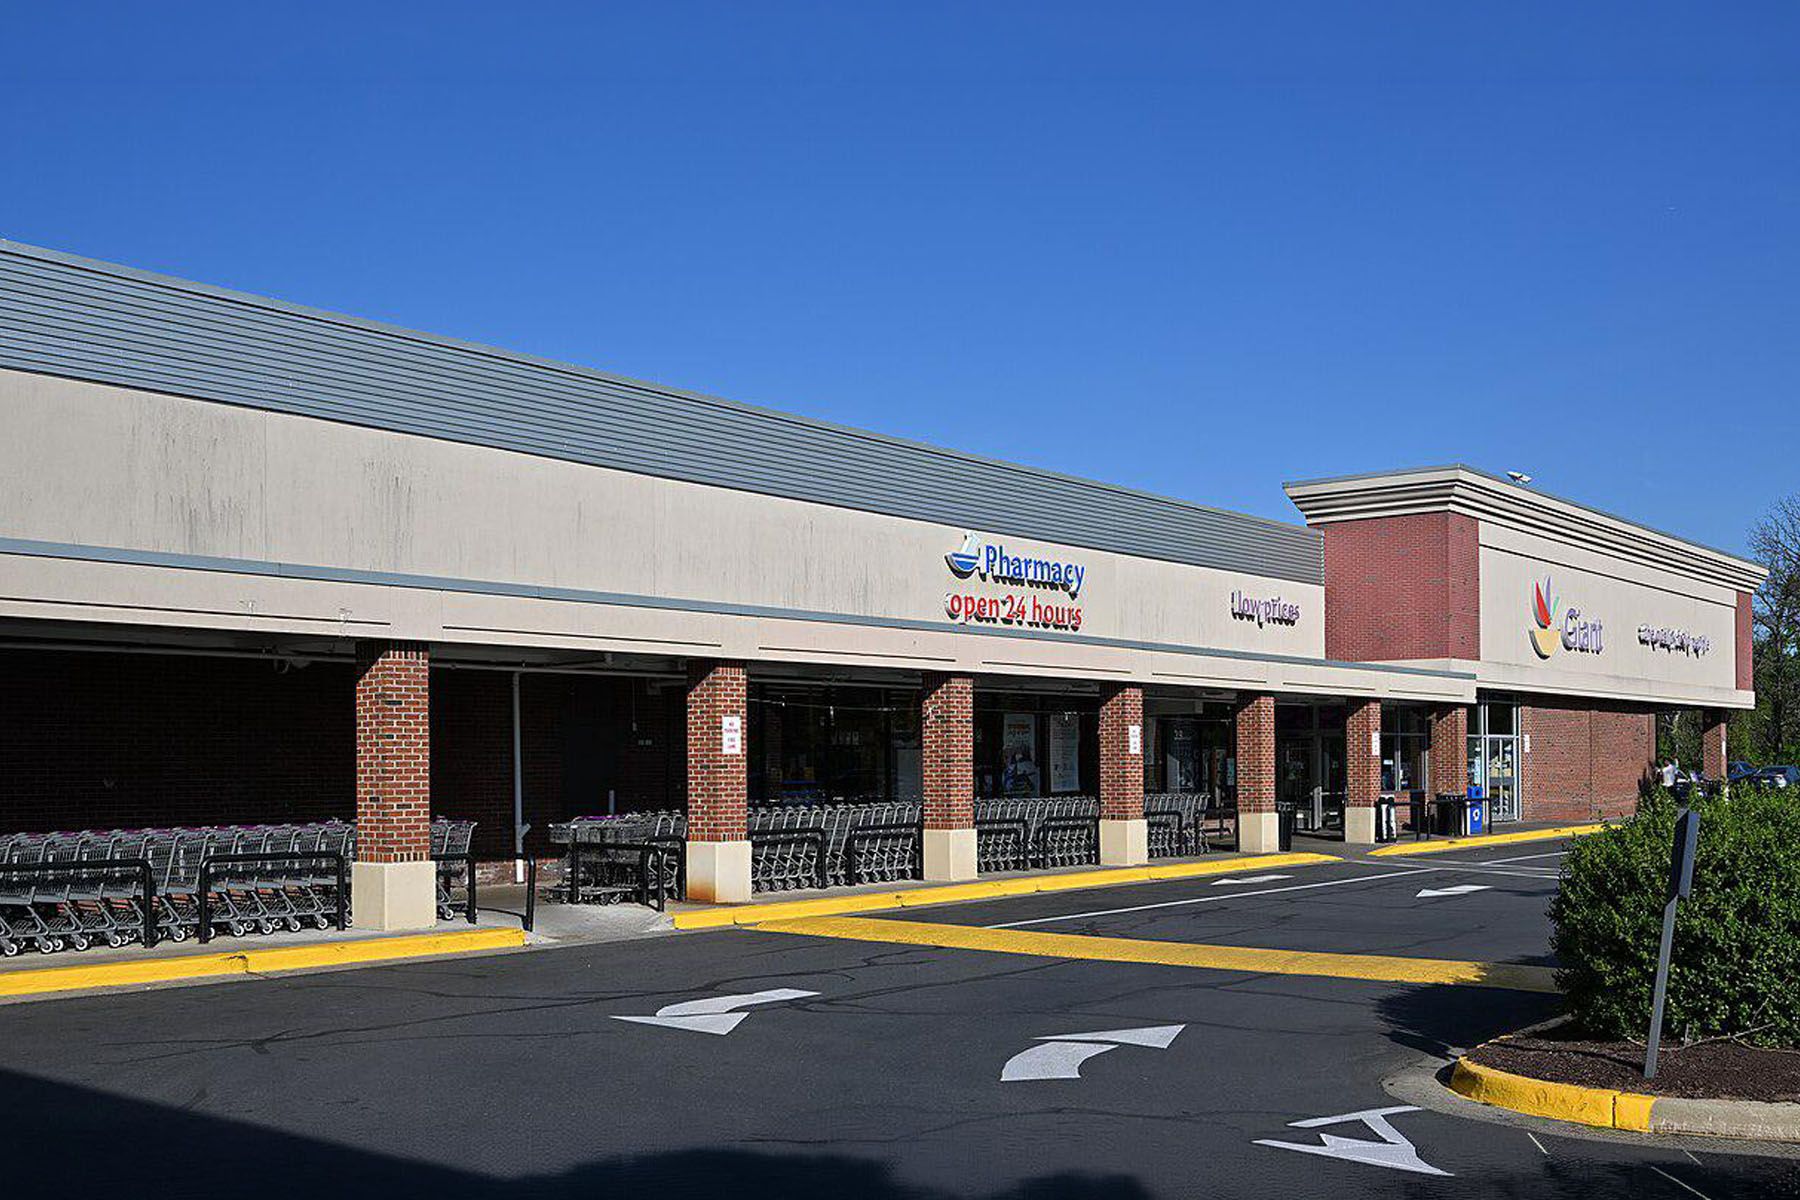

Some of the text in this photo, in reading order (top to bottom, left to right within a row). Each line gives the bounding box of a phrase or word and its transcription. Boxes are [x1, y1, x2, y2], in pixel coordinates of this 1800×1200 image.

[985, 545, 1085, 592] Pharmacy
[950, 594, 1082, 626] open 24 hours
[1264, 597, 1300, 621] prices
[1564, 608, 1603, 651] Giant
